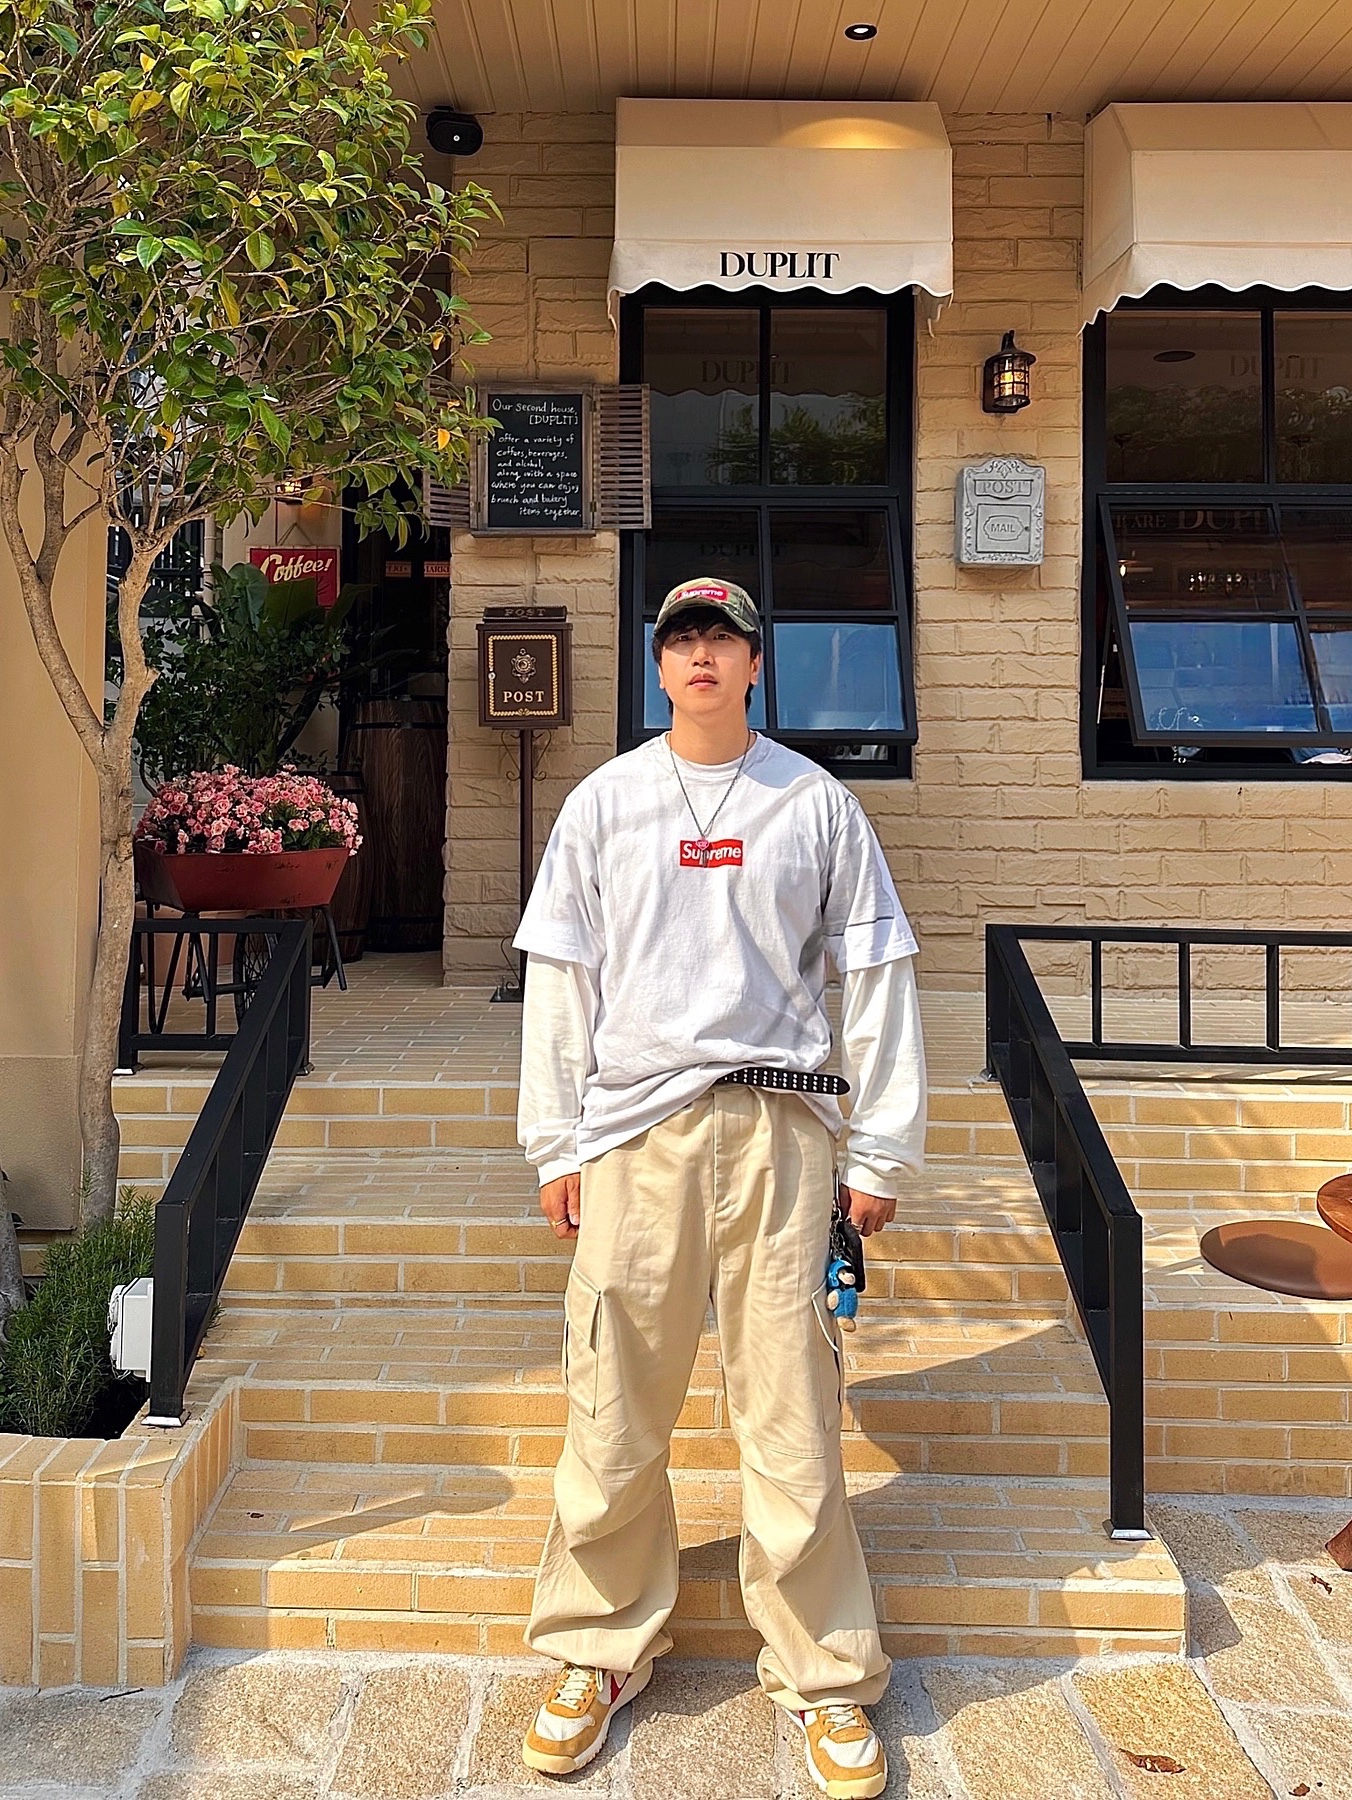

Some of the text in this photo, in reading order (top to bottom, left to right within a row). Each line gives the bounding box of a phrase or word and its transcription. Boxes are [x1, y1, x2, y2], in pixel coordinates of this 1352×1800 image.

[720, 252, 840, 279] DUPLIT
[492, 398, 513, 411] Our
[515, 401, 547, 412] second
[529, 414, 579, 426] [DUPLIT]
[498, 432, 521, 443] offer
[533, 435, 563, 448] variety
[565, 433, 575, 444] of
[497, 459, 512, 467] and
[496, 468, 521, 481] along
[556, 471, 578, 482] space
[491, 480, 517, 489] where
[519, 483, 535, 494] you
[557, 482, 579, 494] enjoy
[982, 481, 1027, 494] POST
[490, 493, 568, 508] brunch and bakery
[519, 507, 541, 516] items
[990, 523, 1016, 533] MAIL
[260, 553, 333, 583] Coffee!
[681, 589, 724, 598] Supreme
[503, 608, 547, 616] POST
[502, 690, 545, 702] POST
[681, 842, 742, 865] Supreme
